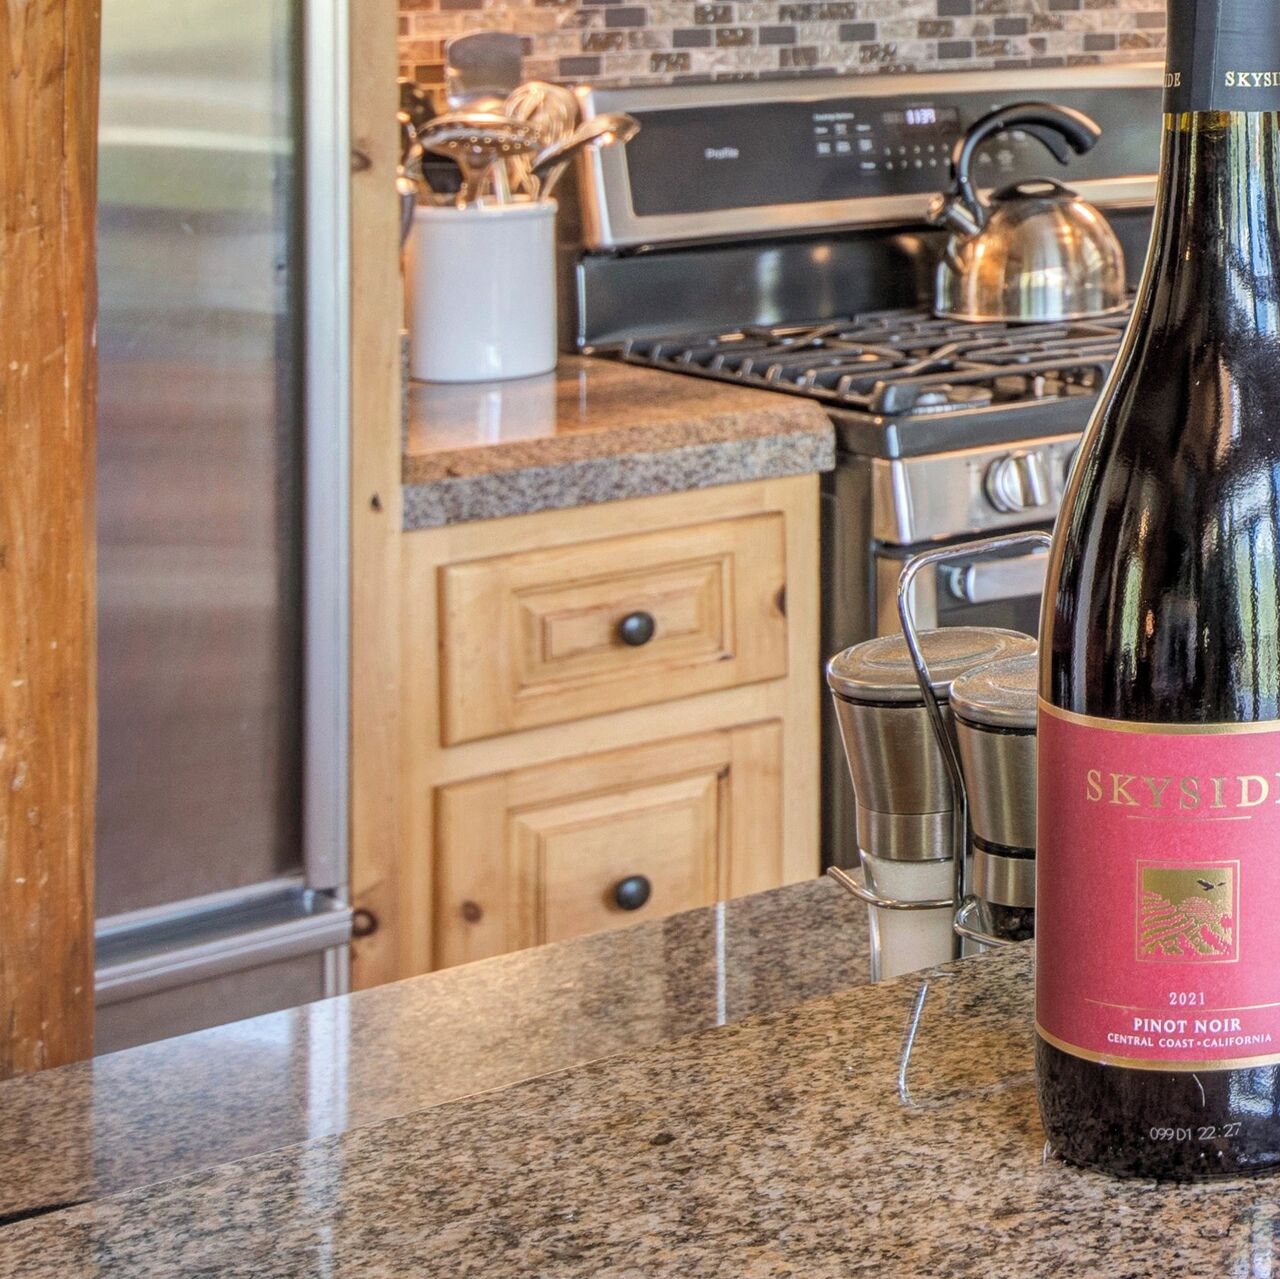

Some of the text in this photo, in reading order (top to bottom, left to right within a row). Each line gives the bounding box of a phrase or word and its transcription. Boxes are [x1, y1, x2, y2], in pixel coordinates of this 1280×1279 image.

[1169, 991, 1206, 1006] 2021
[1133, 1017, 1242, 1034] PINOT NOIR
[1107, 1033, 1154, 1048] CENTRAL
[1197, 1121, 1242, 1141] 22:27
